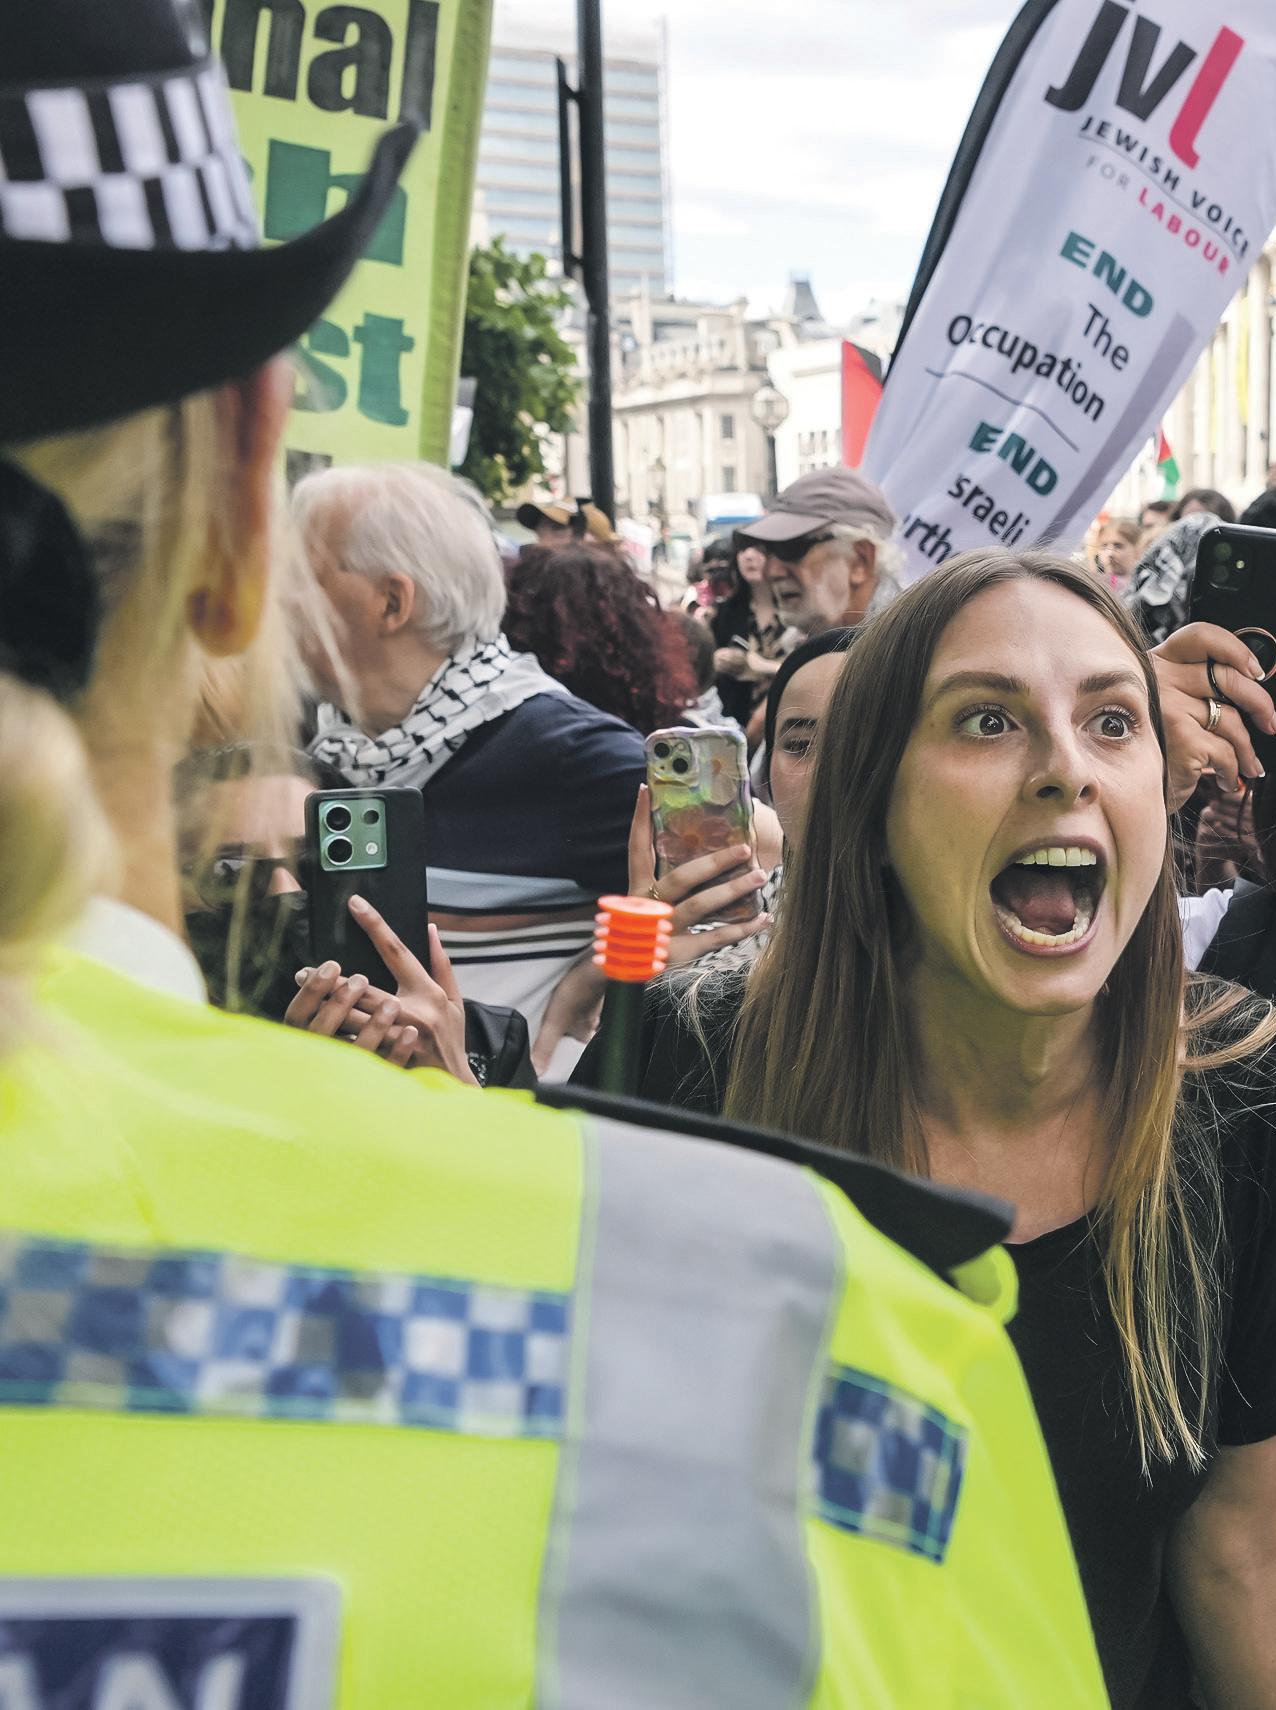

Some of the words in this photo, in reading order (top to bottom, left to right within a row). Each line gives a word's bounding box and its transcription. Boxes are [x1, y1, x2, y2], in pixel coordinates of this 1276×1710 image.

[200, 0, 440, 132] nal
[1044, 0, 1245, 170] jvl
[1080, 116, 1180, 192] JEWISH
[1086, 154, 1130, 191] FOR
[1138, 187, 1230, 278] LABOUR
[1060, 231, 1155, 318] END
[946, 314, 1106, 422] Occupation
[1083, 302, 1130, 371] The
[968, 421, 1059, 496] END
[902, 512, 960, 565] rth
[947, 475, 1030, 547] sraeli
